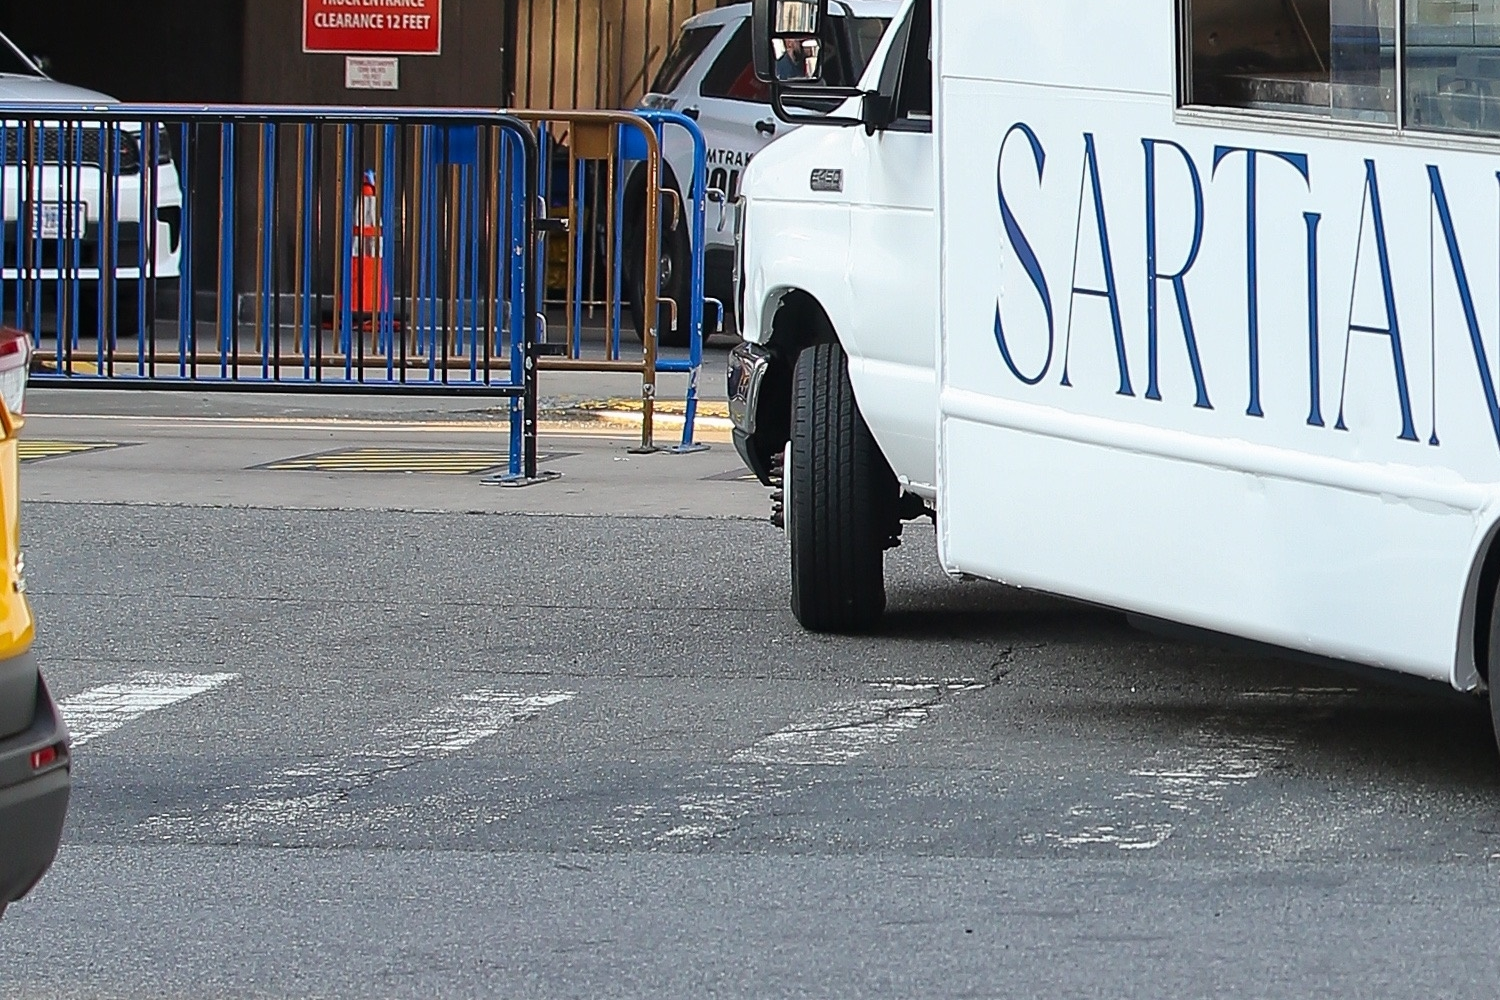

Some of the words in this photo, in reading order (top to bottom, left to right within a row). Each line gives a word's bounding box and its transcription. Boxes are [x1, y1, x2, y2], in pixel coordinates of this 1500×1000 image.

[314, 12, 384, 29] CLEARANCE
[386, 14, 400, 29] 12
[402, 14, 431, 30] FEET
[706, 148, 753, 167] MTRAK
